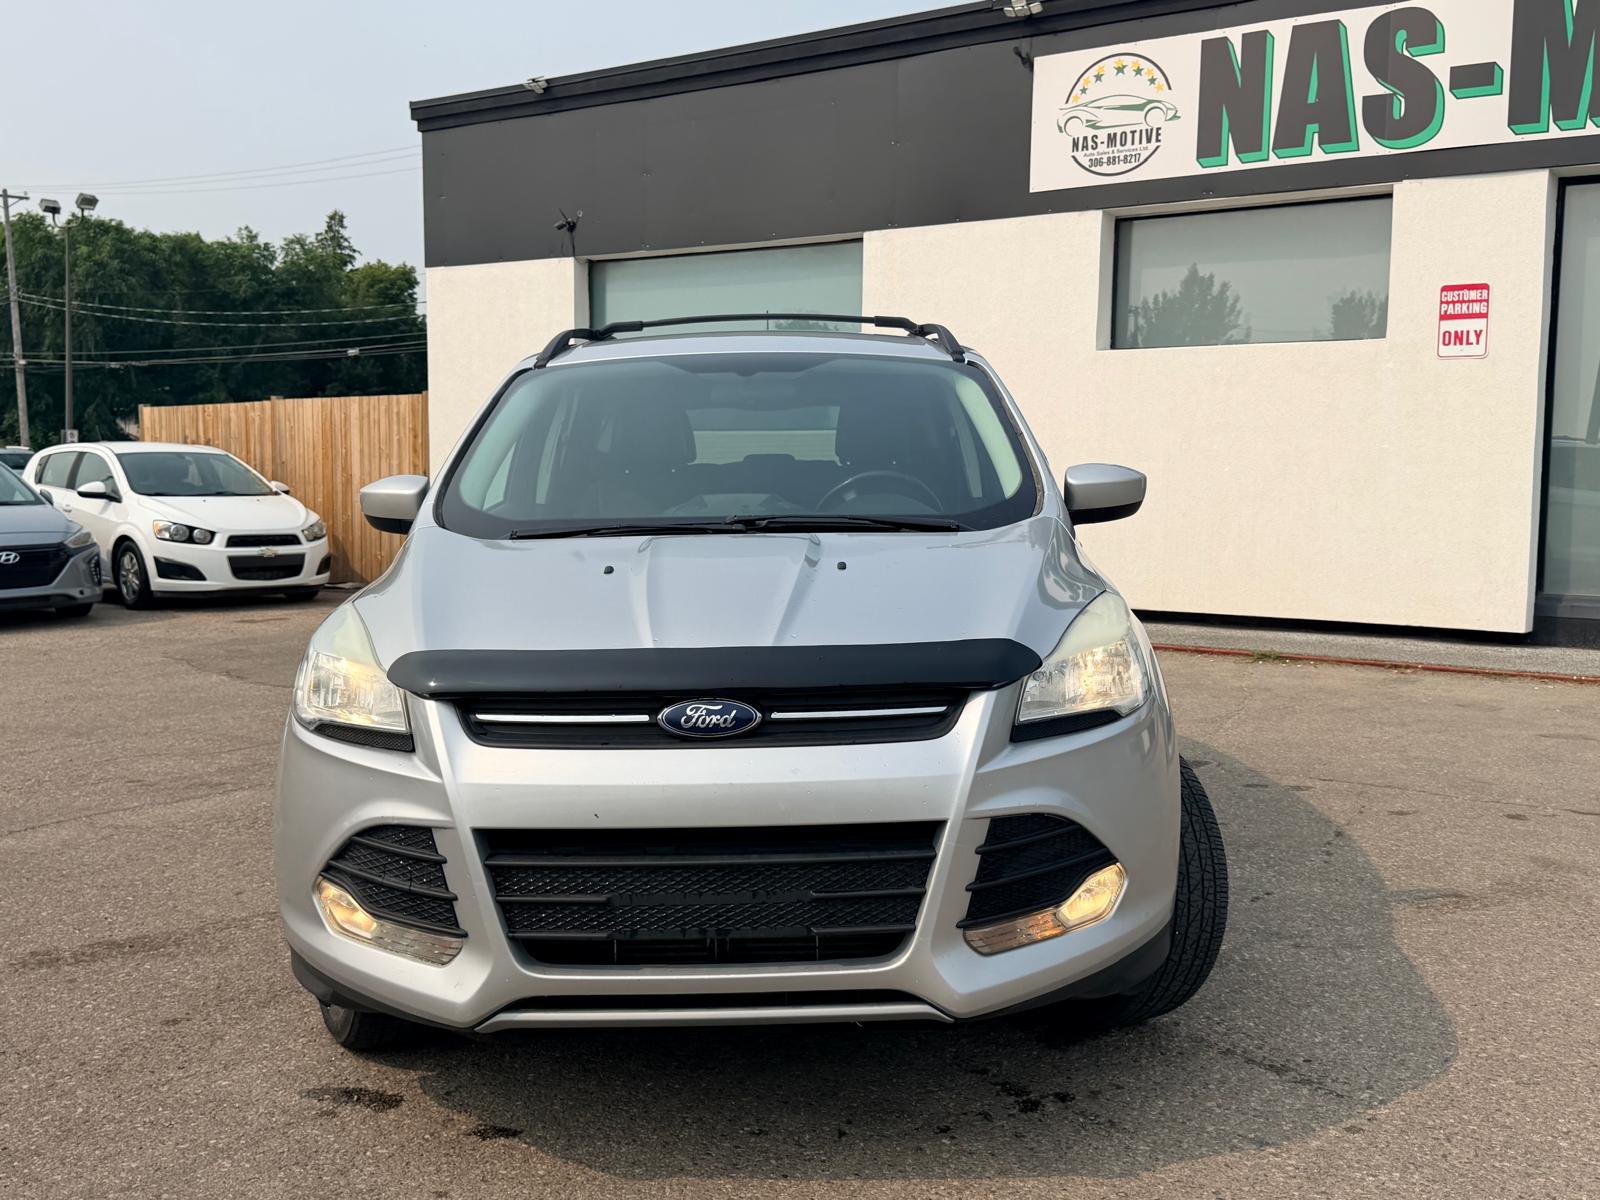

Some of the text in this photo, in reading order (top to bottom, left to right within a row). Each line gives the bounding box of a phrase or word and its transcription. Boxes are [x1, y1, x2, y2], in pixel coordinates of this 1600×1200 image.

[1196, 0, 1600, 168] NAS-M
[1071, 127, 1162, 153] NAS-MOTIVE
[1088, 153, 1141, 168] 306-881-8217
[1441, 289, 1488, 302] CUSTOMER
[1440, 302, 1488, 315] PARKING
[1442, 330, 1483, 346] ONLY
[681, 704, 737, 729] Ford
